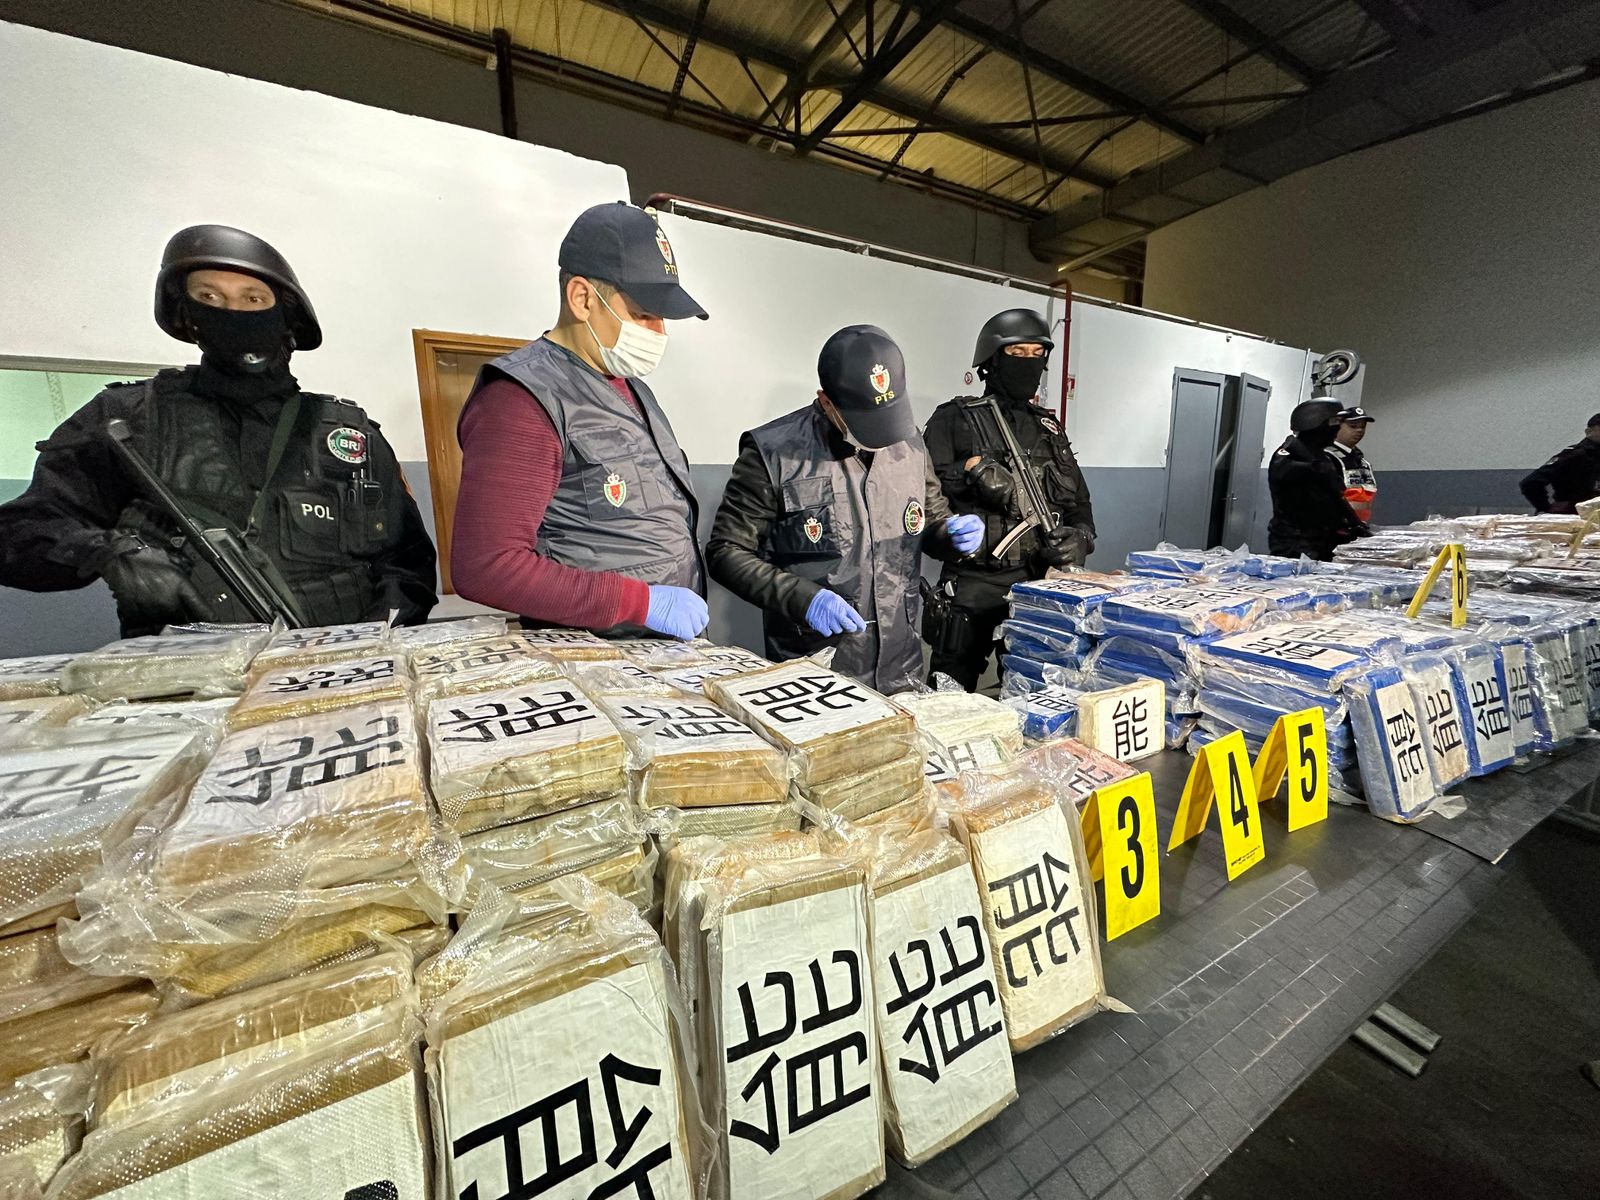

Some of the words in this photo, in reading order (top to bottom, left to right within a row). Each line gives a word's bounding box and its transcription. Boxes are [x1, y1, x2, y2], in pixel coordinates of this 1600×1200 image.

[664, 263, 678, 275] PT
[874, 390, 895, 405] PTS
[340, 438, 361, 451] BRI
[301, 503, 335, 520] POL
[1455, 551, 1465, 609] 6
[438, 690, 597, 743] 能
[739, 674, 868, 723] 能
[1112, 696, 1149, 759] 能
[1424, 688, 1461, 758] 能
[1472, 675, 1510, 741] 能
[205, 715, 406, 804] 能
[1299, 722, 1318, 802] 5
[1386, 707, 1425, 783] 能
[1227, 751, 1250, 839] 4
[1117, 796, 1145, 899] 3
[988, 851, 1081, 989] 能
[885, 914, 1003, 1084] 能
[726, 949, 871, 1155] 能
